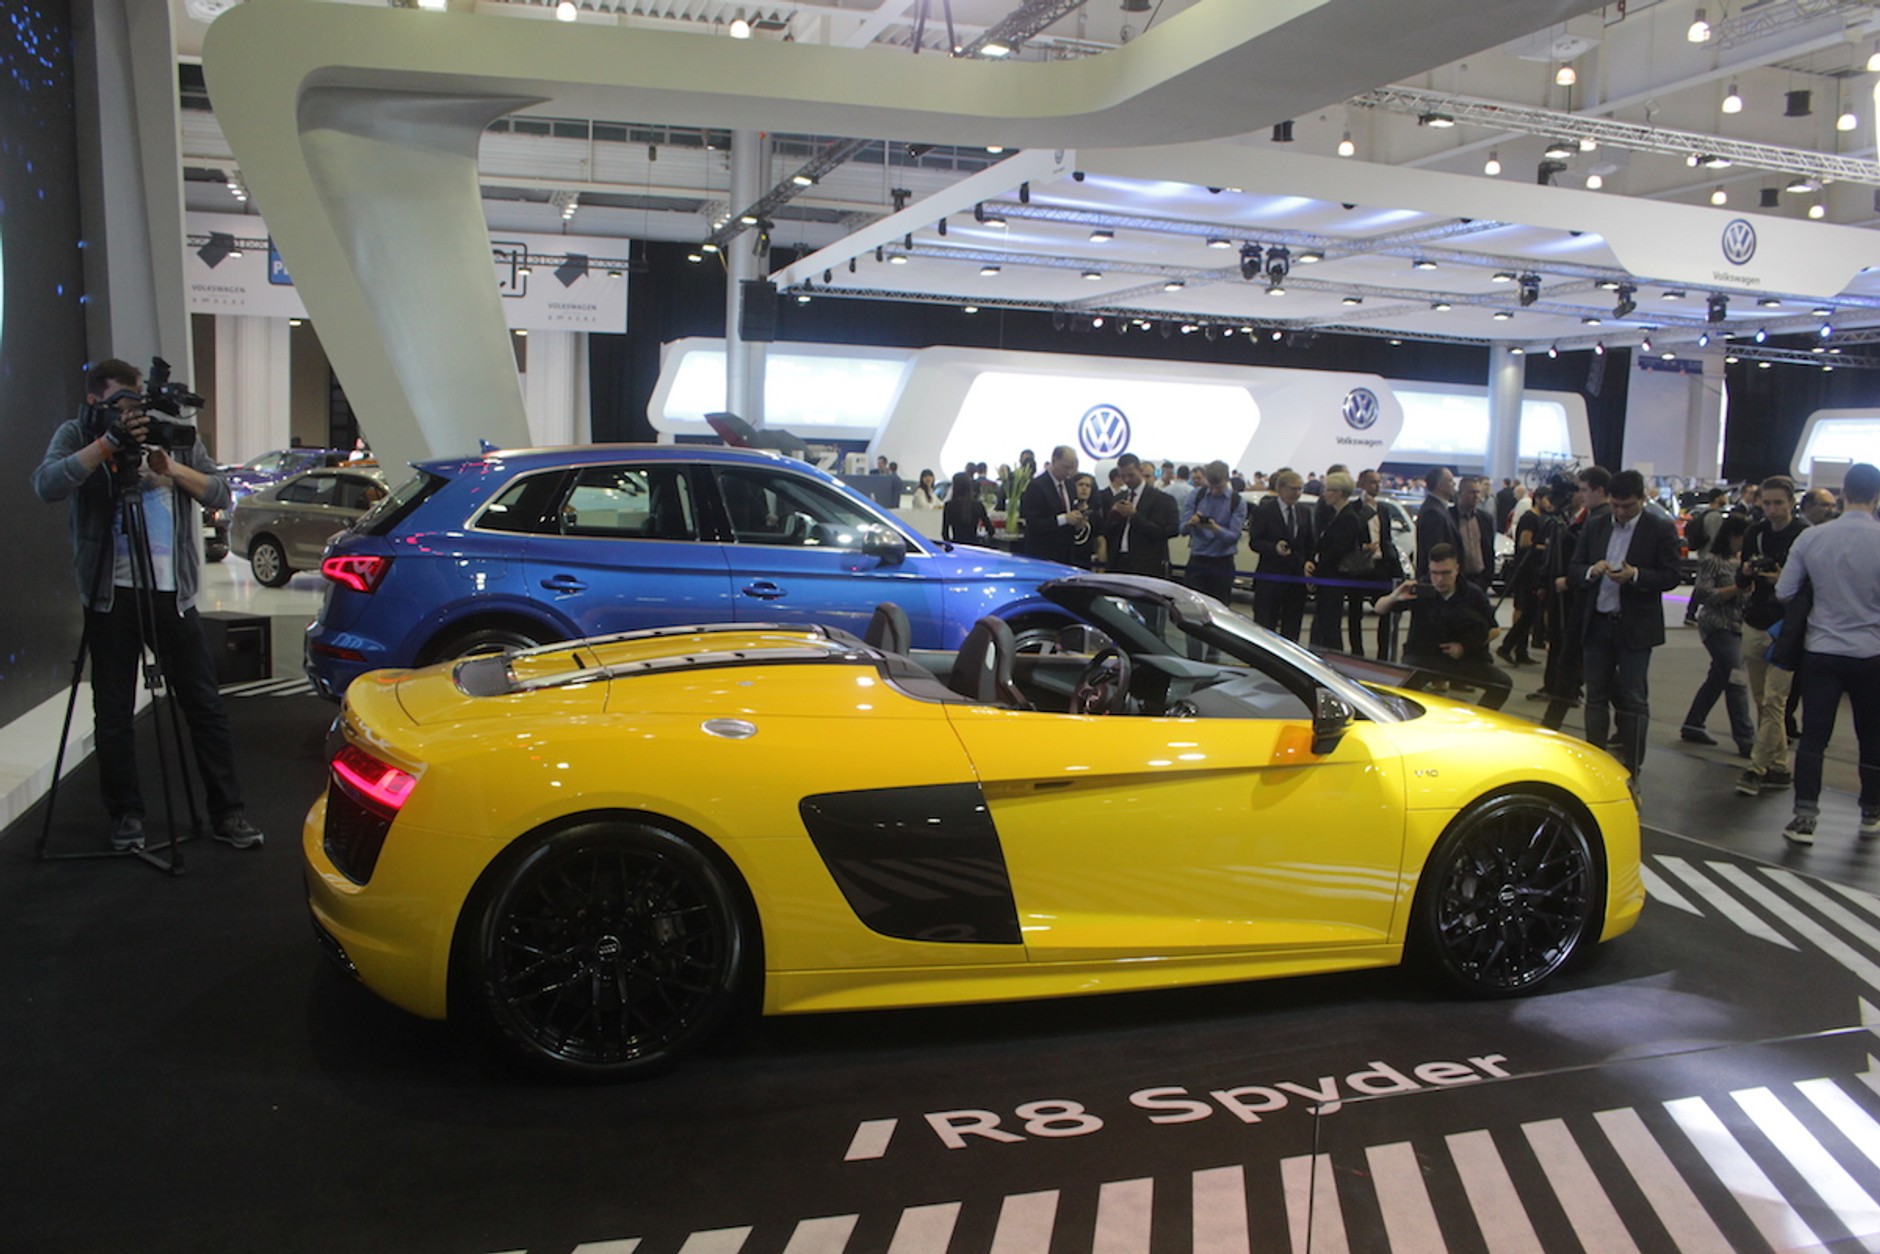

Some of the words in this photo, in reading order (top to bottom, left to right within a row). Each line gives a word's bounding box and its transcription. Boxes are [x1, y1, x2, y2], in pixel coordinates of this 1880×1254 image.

[1712, 270, 1761, 286] Volkswagen
[191, 284, 246, 293] VOLKSWAGEN
[547, 303, 597, 311] VOLKSWAGEN
[1335, 436, 1384, 448] Volkswagen
[924, 1100, 1104, 1149] R8
[1128, 1053, 1513, 1125] Spyder
